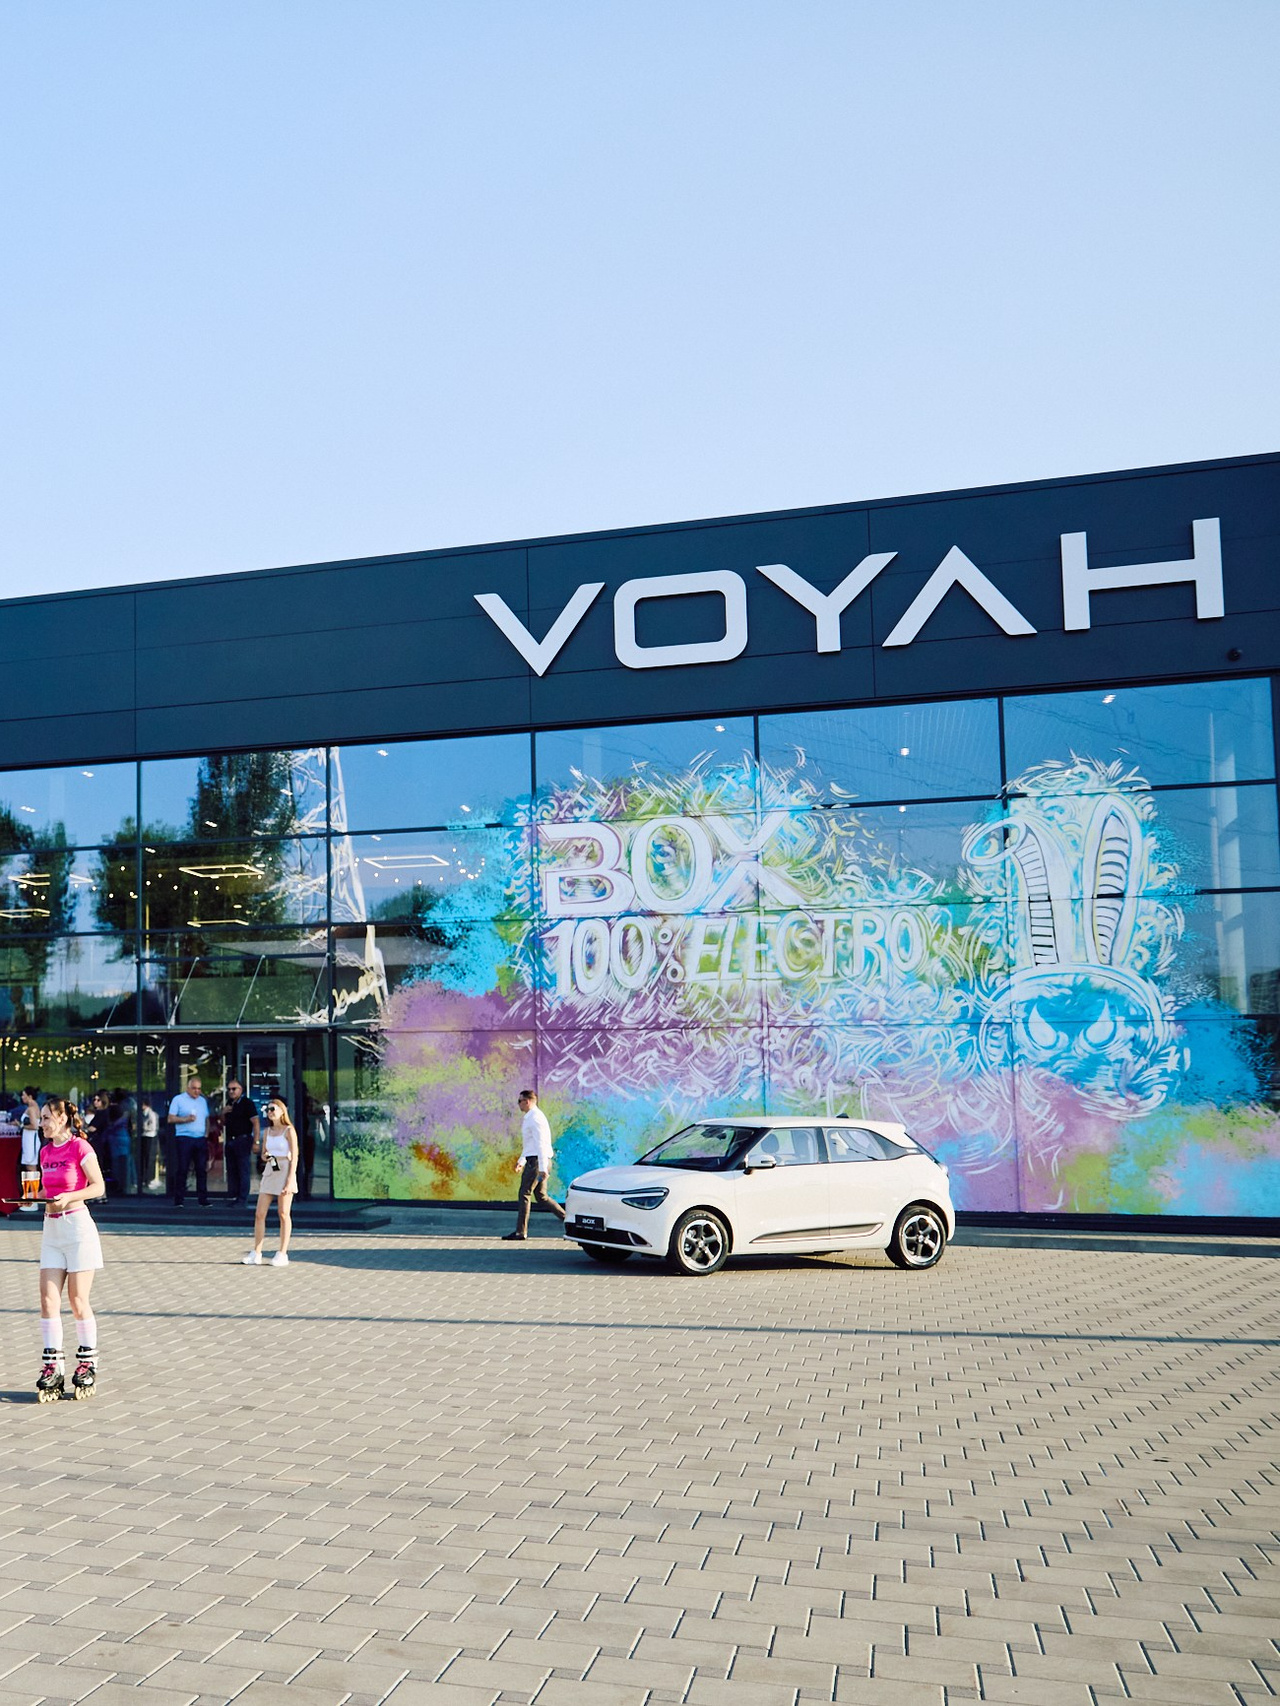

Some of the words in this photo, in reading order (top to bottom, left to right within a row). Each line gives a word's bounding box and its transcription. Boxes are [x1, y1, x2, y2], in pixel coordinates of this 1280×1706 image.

[473, 517, 1226, 677] VOYAH
[536, 811, 807, 917] BOX
[541, 915, 685, 998] 100%
[686, 910, 926, 984] ELECTRO
[123, 1045, 191, 1055] SRVE
[43, 1160, 67, 1169] BOX
